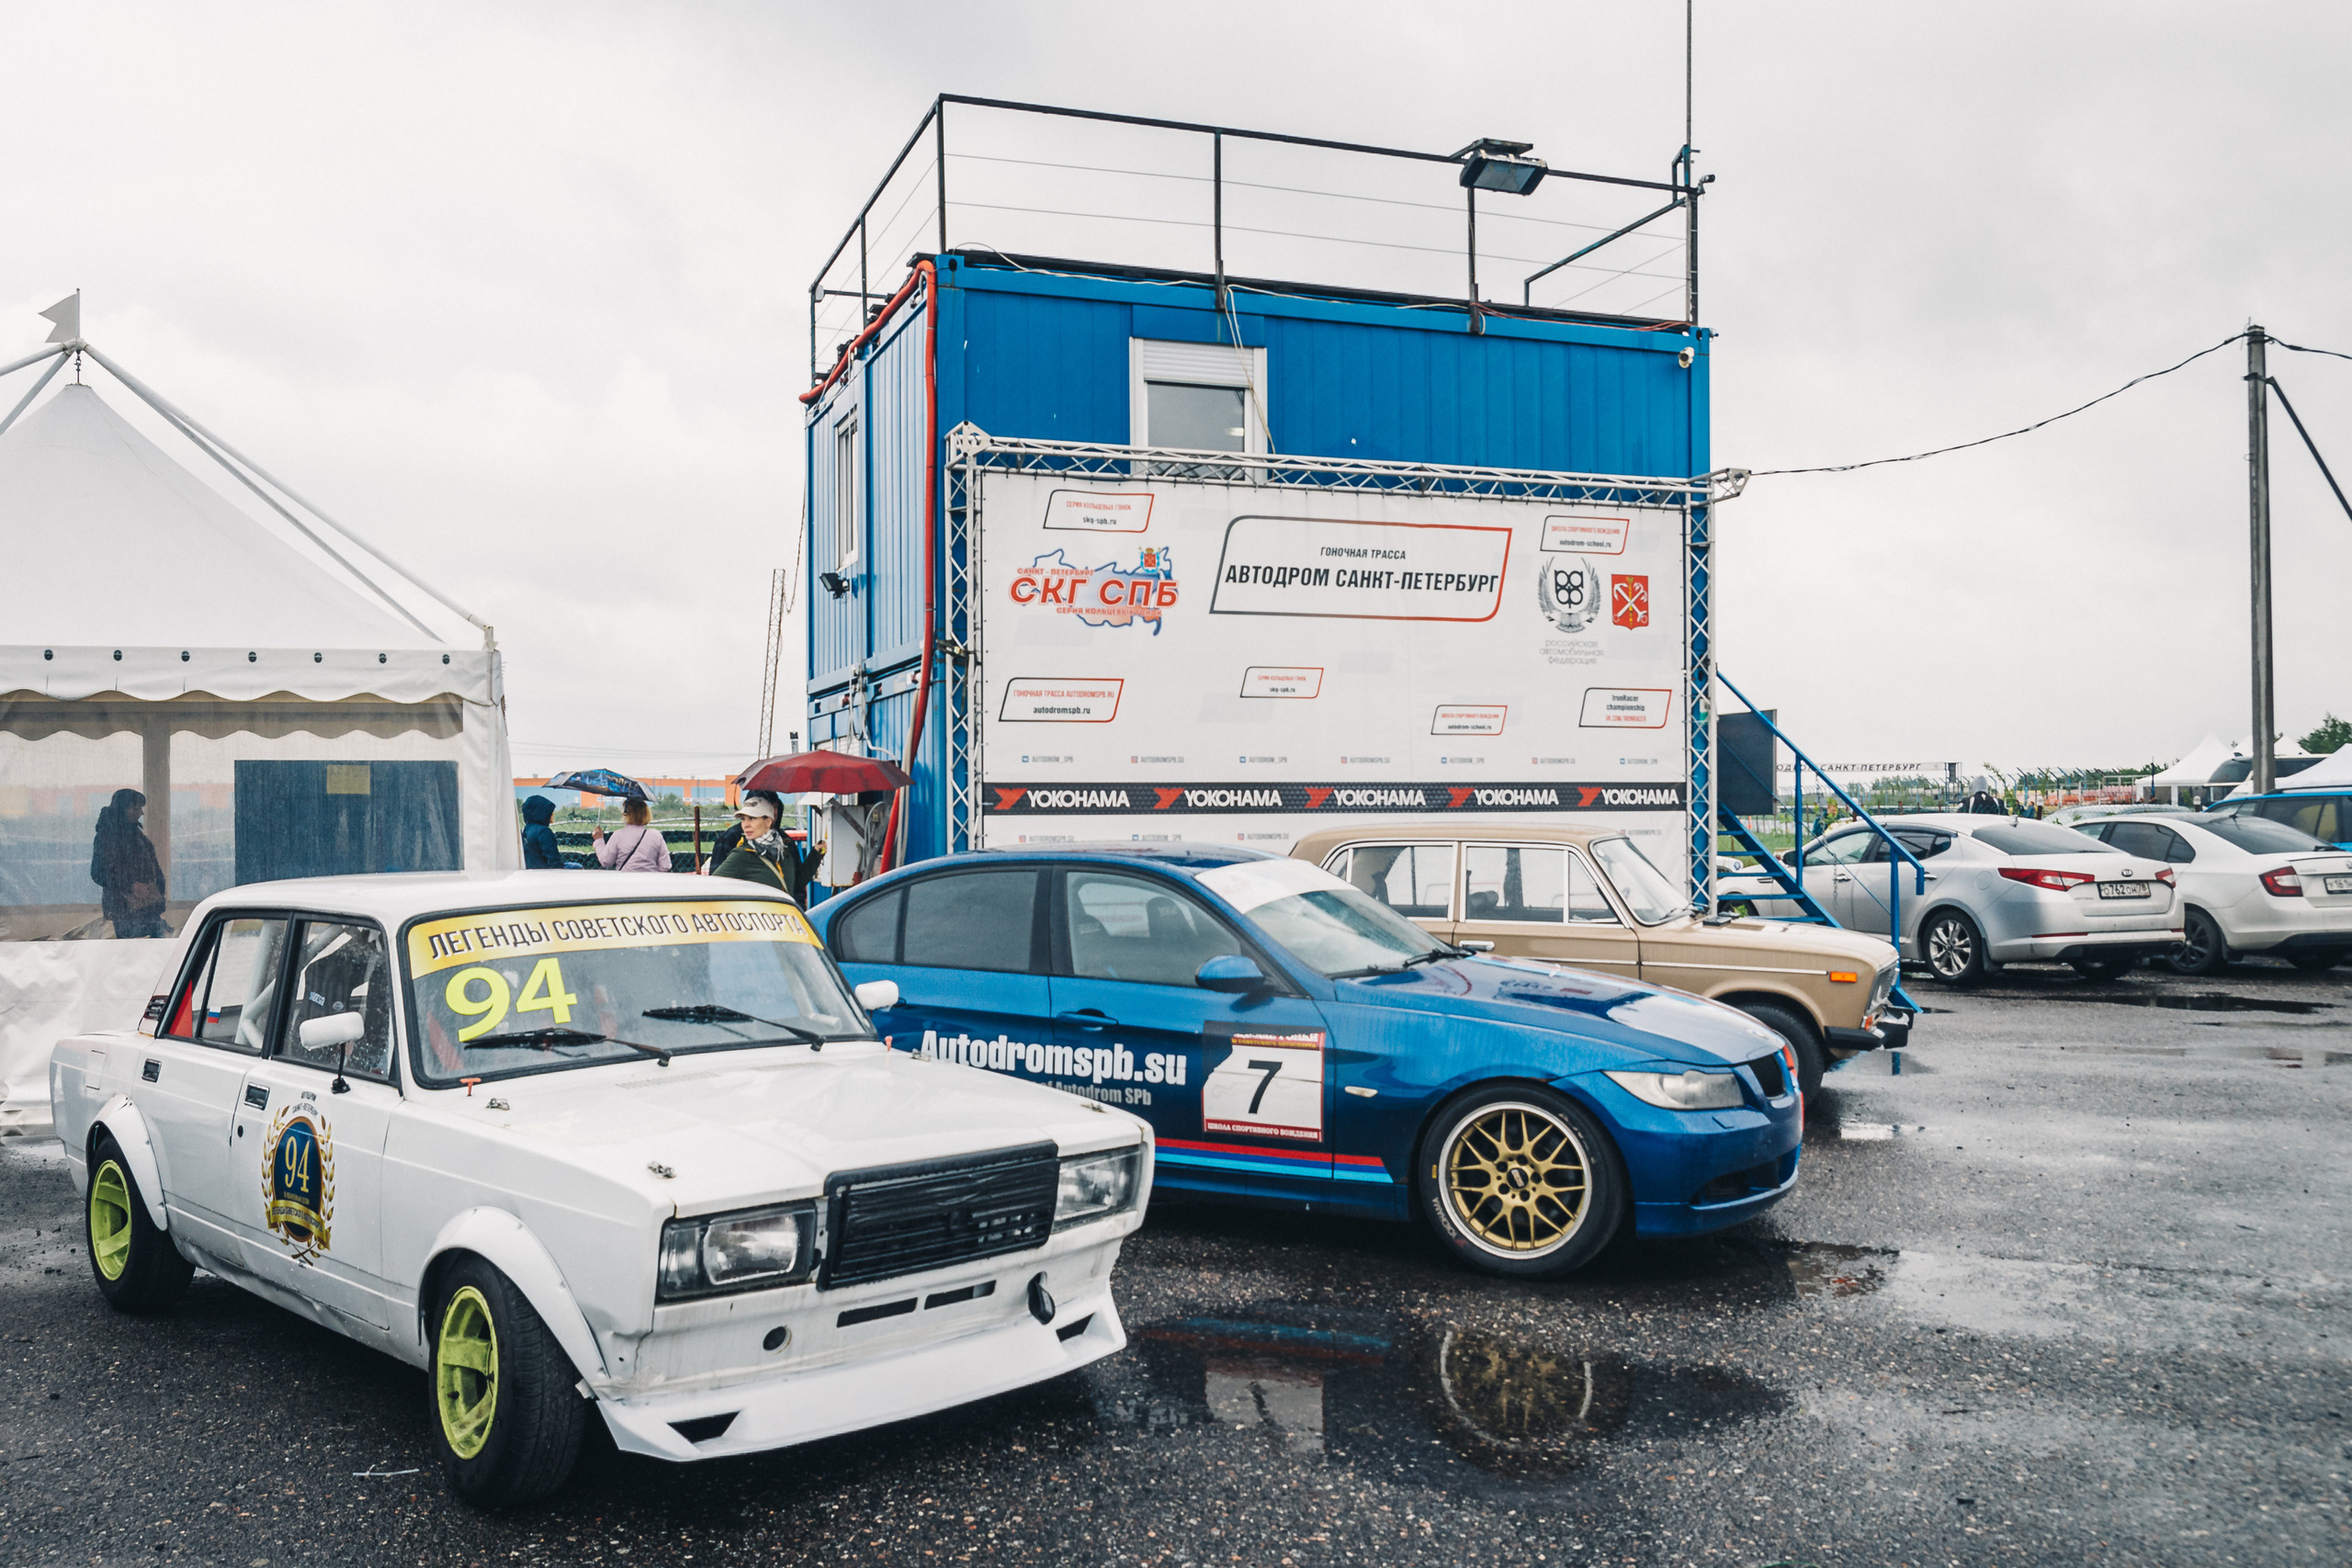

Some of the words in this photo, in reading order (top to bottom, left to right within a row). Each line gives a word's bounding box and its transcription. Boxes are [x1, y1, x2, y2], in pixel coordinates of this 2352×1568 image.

[1320, 547, 1368, 558] ГОНОЧНАЯ
[1371, 549, 1407, 559] ТРАССА
[1225, 564, 1330, 589] АВТОДРОМ
[1335, 569, 1498, 592] САНКТ-ПЕТЕРБУРГ
[1009, 576, 1089, 605] СКГ
[1099, 580, 1179, 608] СПБ
[1034, 706, 1091, 715] autodromspb.ru
[1821, 763, 1922, 772] САНКТ-ПЕТЕРБУРГ
[1027, 790, 1130, 808] YOKOHAMA
[1184, 790, 1283, 807] YOKOHAMA
[1334, 789, 1426, 807] YOKOHAMA
[1474, 789, 1559, 806] YOKOHAMA
[1601, 789, 1679, 806] YOKOHAMA
[428, 921, 552, 959] ЛЕГЕНДЫ
[552, 914, 690, 942] СОВЕТСКОГО
[690, 912, 809, 937] АВТОСПОРТА
[446, 957, 578, 1043] 94
[920, 1030, 1187, 1086] Autodromspb.su
[1248, 1059, 1283, 1114] 7
[1125, 1087, 1152, 1106] SPb
[1207, 1122, 1231, 1131] ШКОЛА
[1232, 1124, 1280, 1135] СПОРТИВНОГО
[1280, 1128, 1318, 1139] ВОЖДЕНИЯ
[284, 1135, 311, 1193] 94
